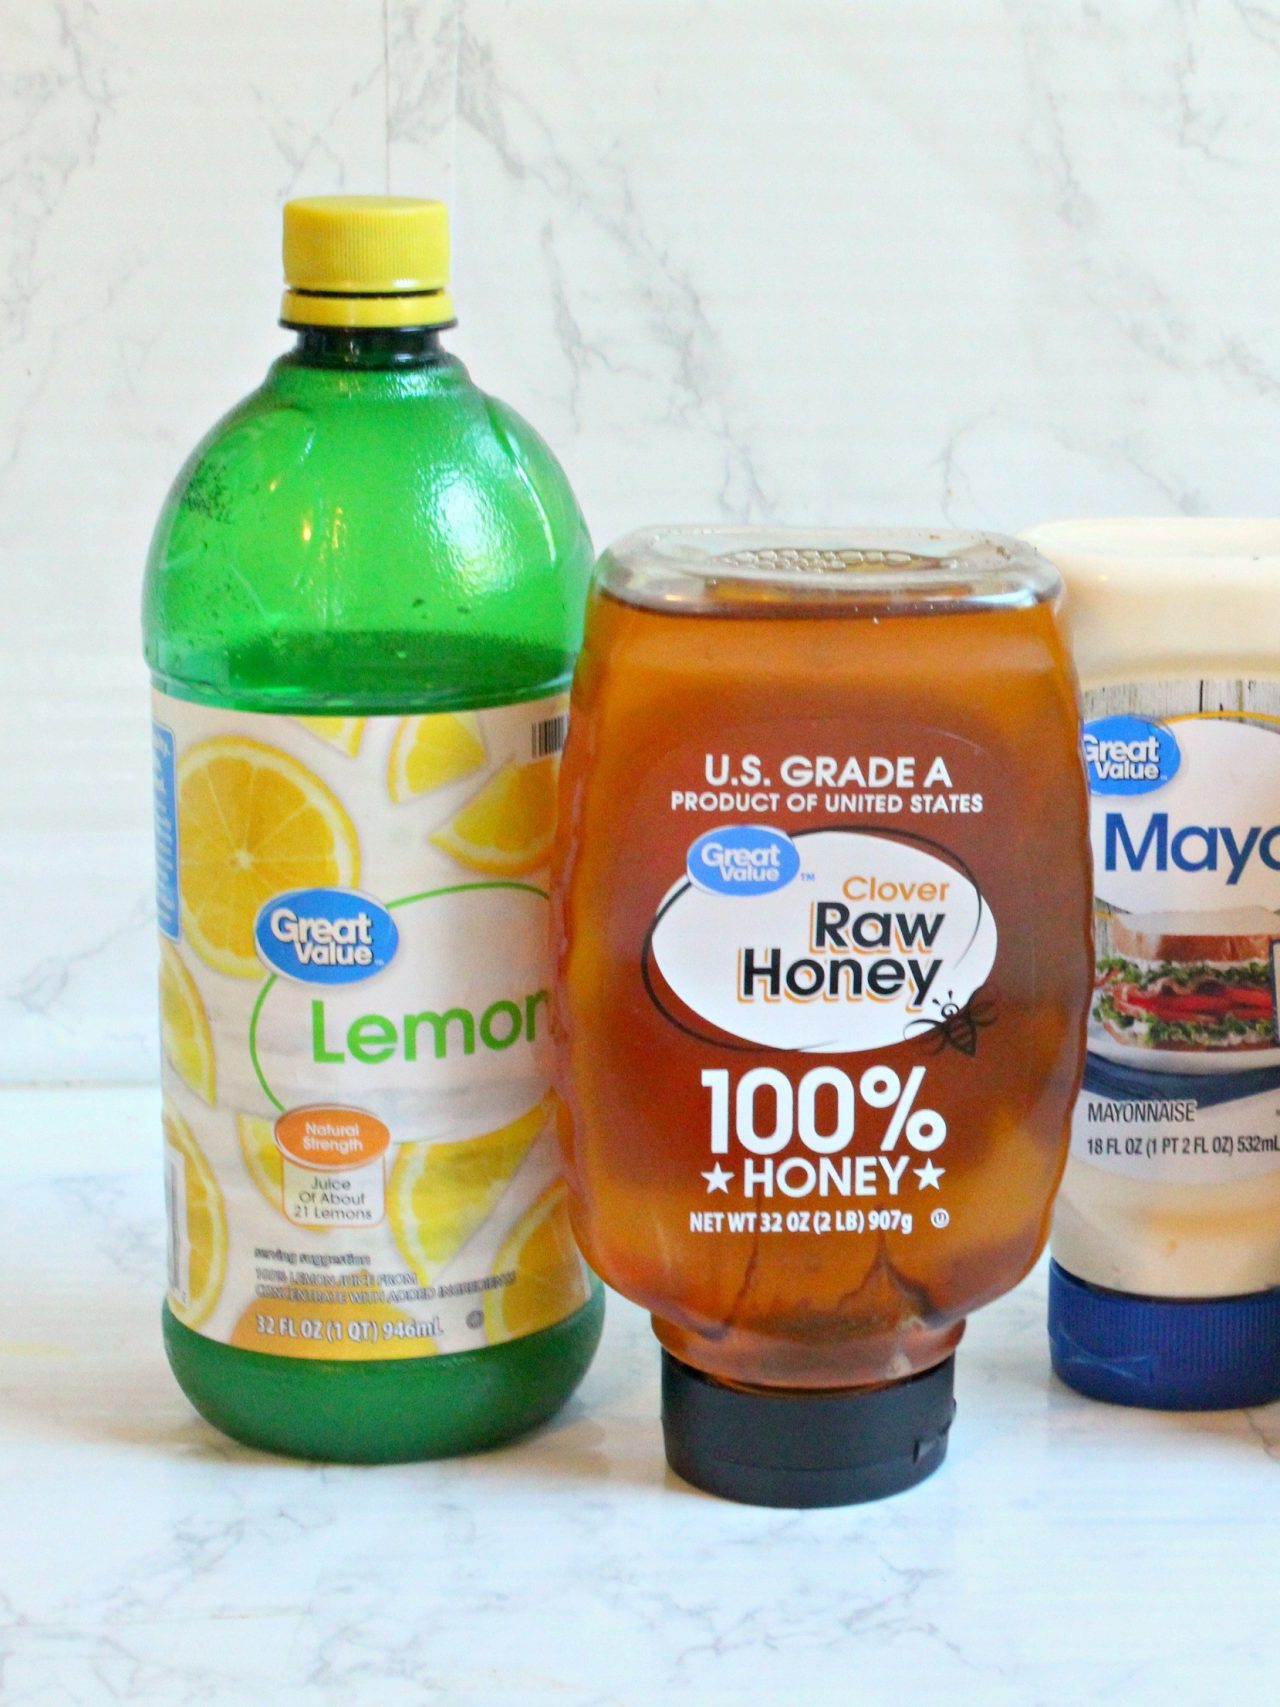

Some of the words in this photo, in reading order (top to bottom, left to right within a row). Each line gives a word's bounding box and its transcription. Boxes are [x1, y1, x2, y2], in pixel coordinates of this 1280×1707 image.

[1082, 734, 1160, 763] Great
[704, 753, 771, 788] U.S.
[780, 756, 915, 789] GRADE
[923, 756, 953, 789] A
[1094, 760, 1160, 781] Value
[671, 791, 780, 812] PRODUCT
[786, 793, 818, 812] OF
[825, 793, 903, 813] UNITED
[909, 794, 984, 813] STATES
[701, 842, 780, 867] Great
[719, 865, 780, 882] Value
[842, 876, 950, 902] Clover
[270, 908, 373, 946] Great
[809, 901, 946, 954] Raw
[294, 941, 373, 967] Value
[737, 948, 944, 1012] Honey
[701, 1065, 947, 1155] 100%
[1087, 1101, 1197, 1123] MAYONNAISE
[305, 1121, 360, 1137] Natural
[303, 1136, 364, 1155] Strength
[1087, 1138, 1103, 1154] 18
[1106, 1138, 1122, 1155] FL
[1125, 1138, 1143, 1155] OZ
[1146, 1137, 1157, 1159] (1
[1162, 1137, 1179, 1154] PT
[1182, 1137, 1190, 1154] 2
[1194, 1137, 1209, 1154] FL
[1212, 1136, 1235, 1157] OZ)
[1237, 1135, 1280, 1152] 532mL
[312, 1176, 351, 1190] Juice
[743, 1155, 910, 1198] HONEY
[299, 1191, 315, 1203] Of
[320, 1192, 365, 1205] About
[294, 1206, 308, 1218] 21
[314, 1207, 372, 1220] Lemons
[689, 1211, 725, 1233] NET
[727, 1211, 757, 1233] WT
[760, 1211, 782, 1232] 32
[786, 1211, 809, 1232] OZ
[813, 1210, 832, 1235] (2
[835, 1210, 865, 1234] LB)
[868, 1209, 912, 1235] 907g
[257, 1314, 275, 1334] 32
[279, 1316, 296, 1337] FL
[300, 1318, 323, 1339] OZ
[326, 1319, 343, 1343] (1
[347, 1320, 378, 1343] QT)
[382, 1316, 444, 1339] 946mL
